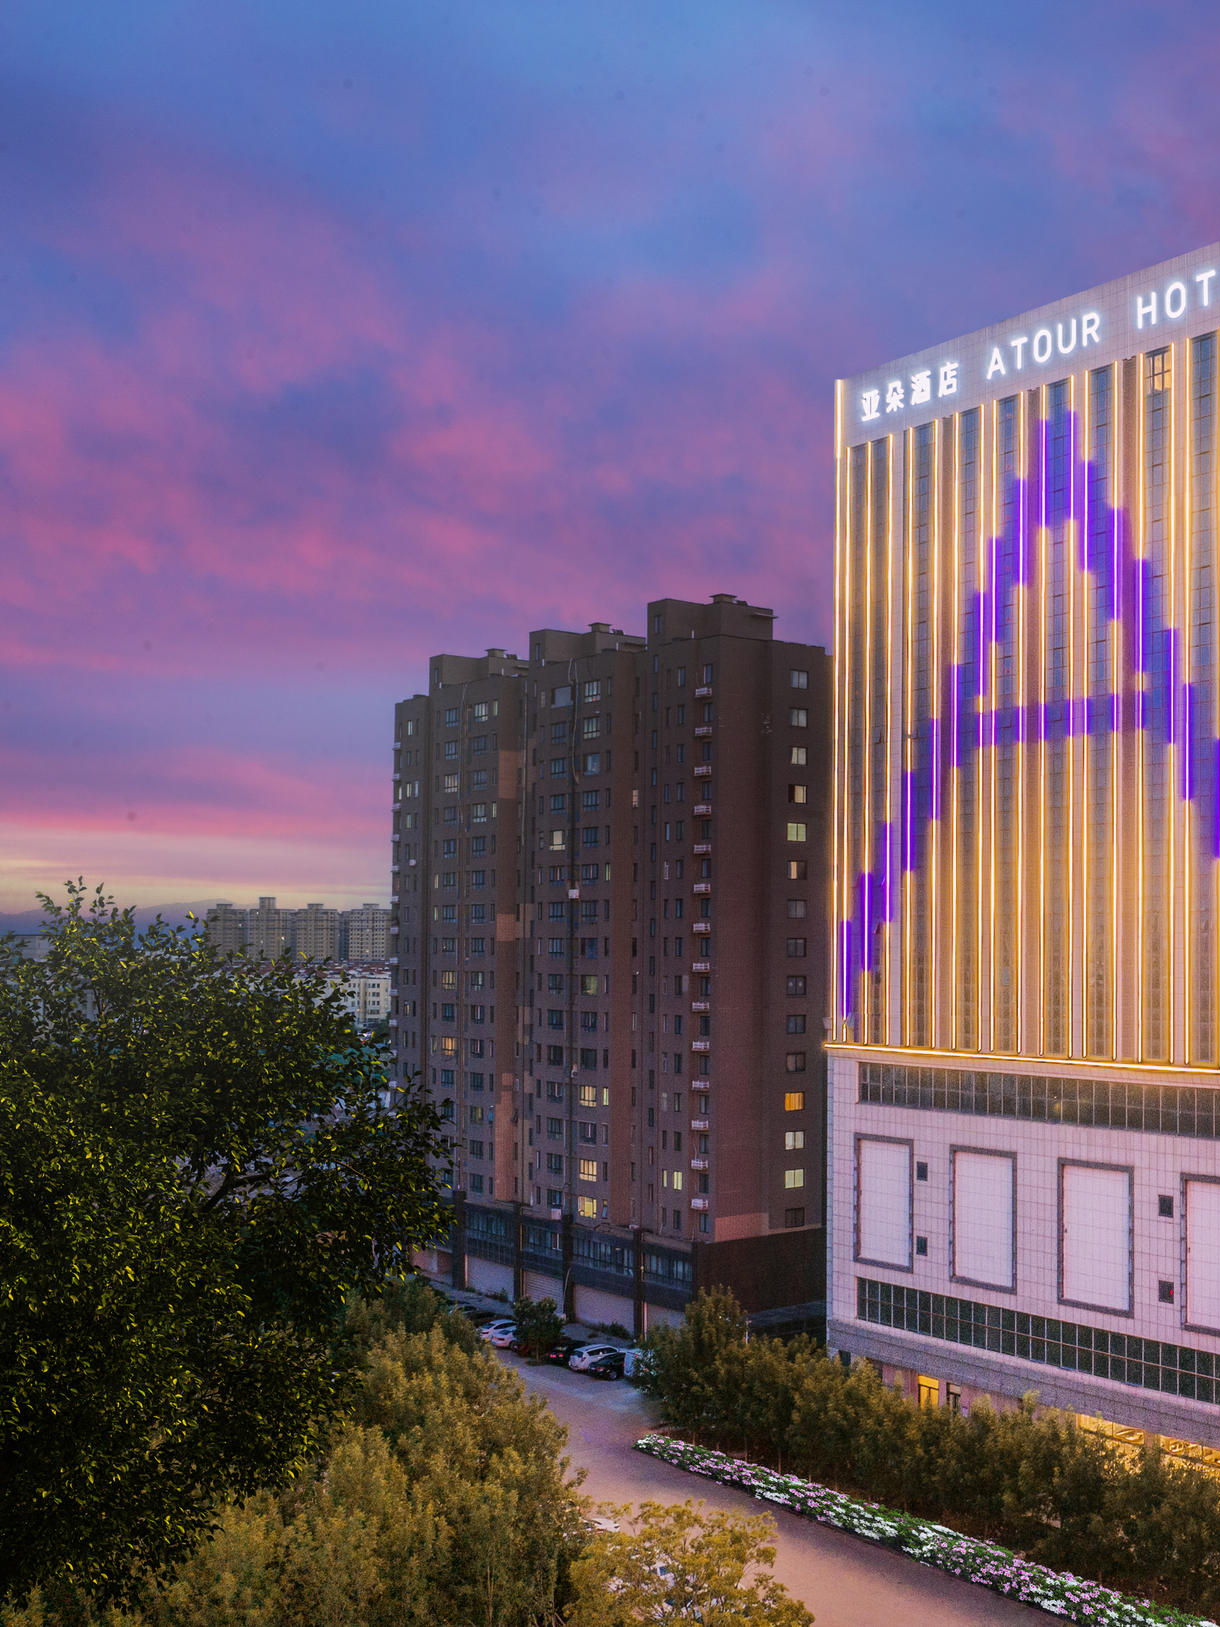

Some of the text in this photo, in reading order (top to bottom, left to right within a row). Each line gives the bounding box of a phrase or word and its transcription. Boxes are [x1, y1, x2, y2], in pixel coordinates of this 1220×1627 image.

[861, 362, 959, 422] 亚朵酒店
[987, 312, 1101, 380] ATOUR
